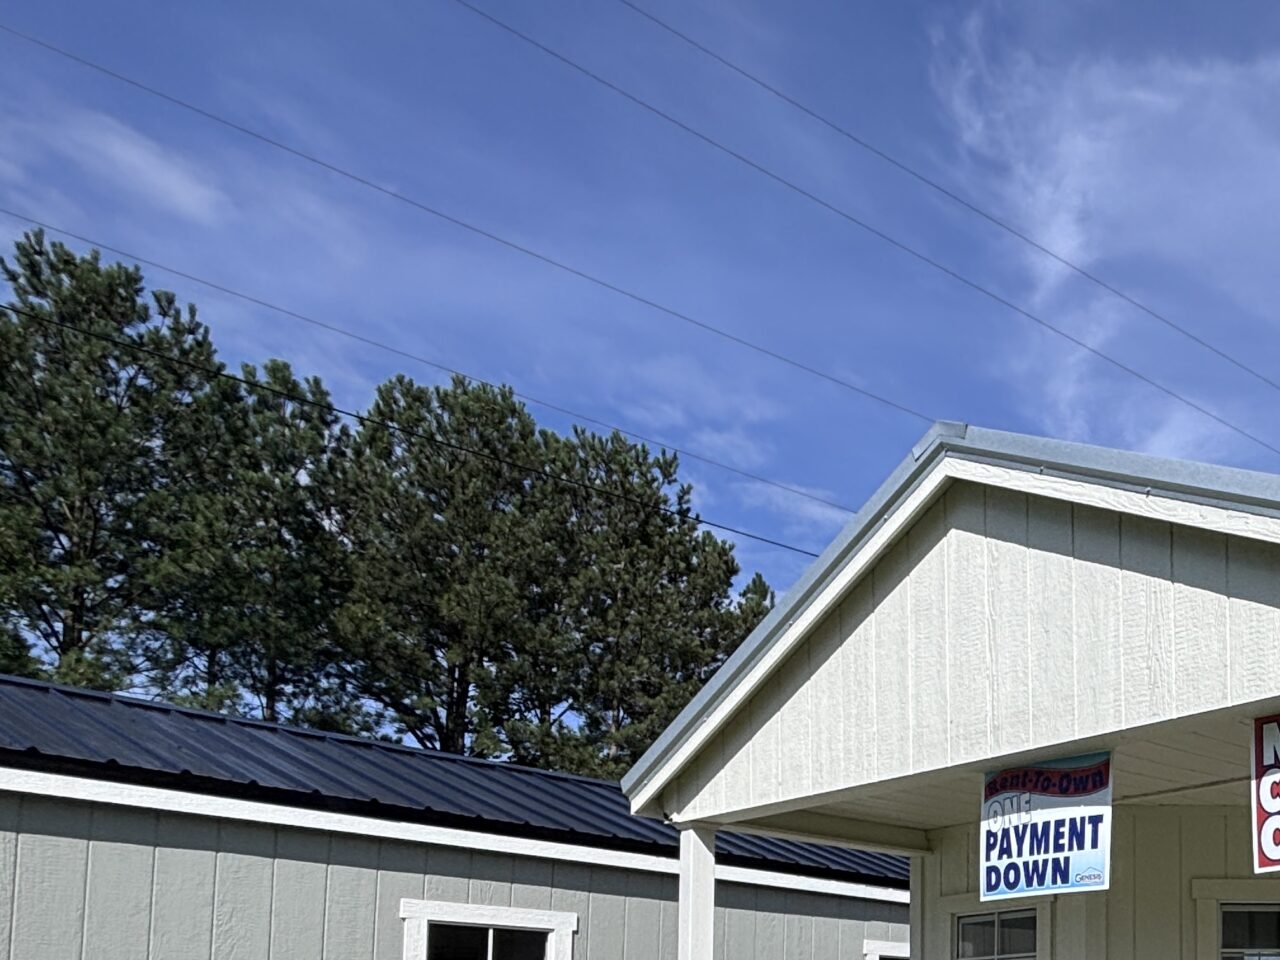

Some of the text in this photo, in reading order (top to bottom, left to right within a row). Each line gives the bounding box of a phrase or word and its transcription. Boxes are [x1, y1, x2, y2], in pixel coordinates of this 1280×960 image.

[986, 769, 1105, 794] Rent-To-Own
[988, 792, 1032, 833] ONE
[985, 814, 1104, 862] PAYMENT
[985, 856, 1071, 893] DOWN
